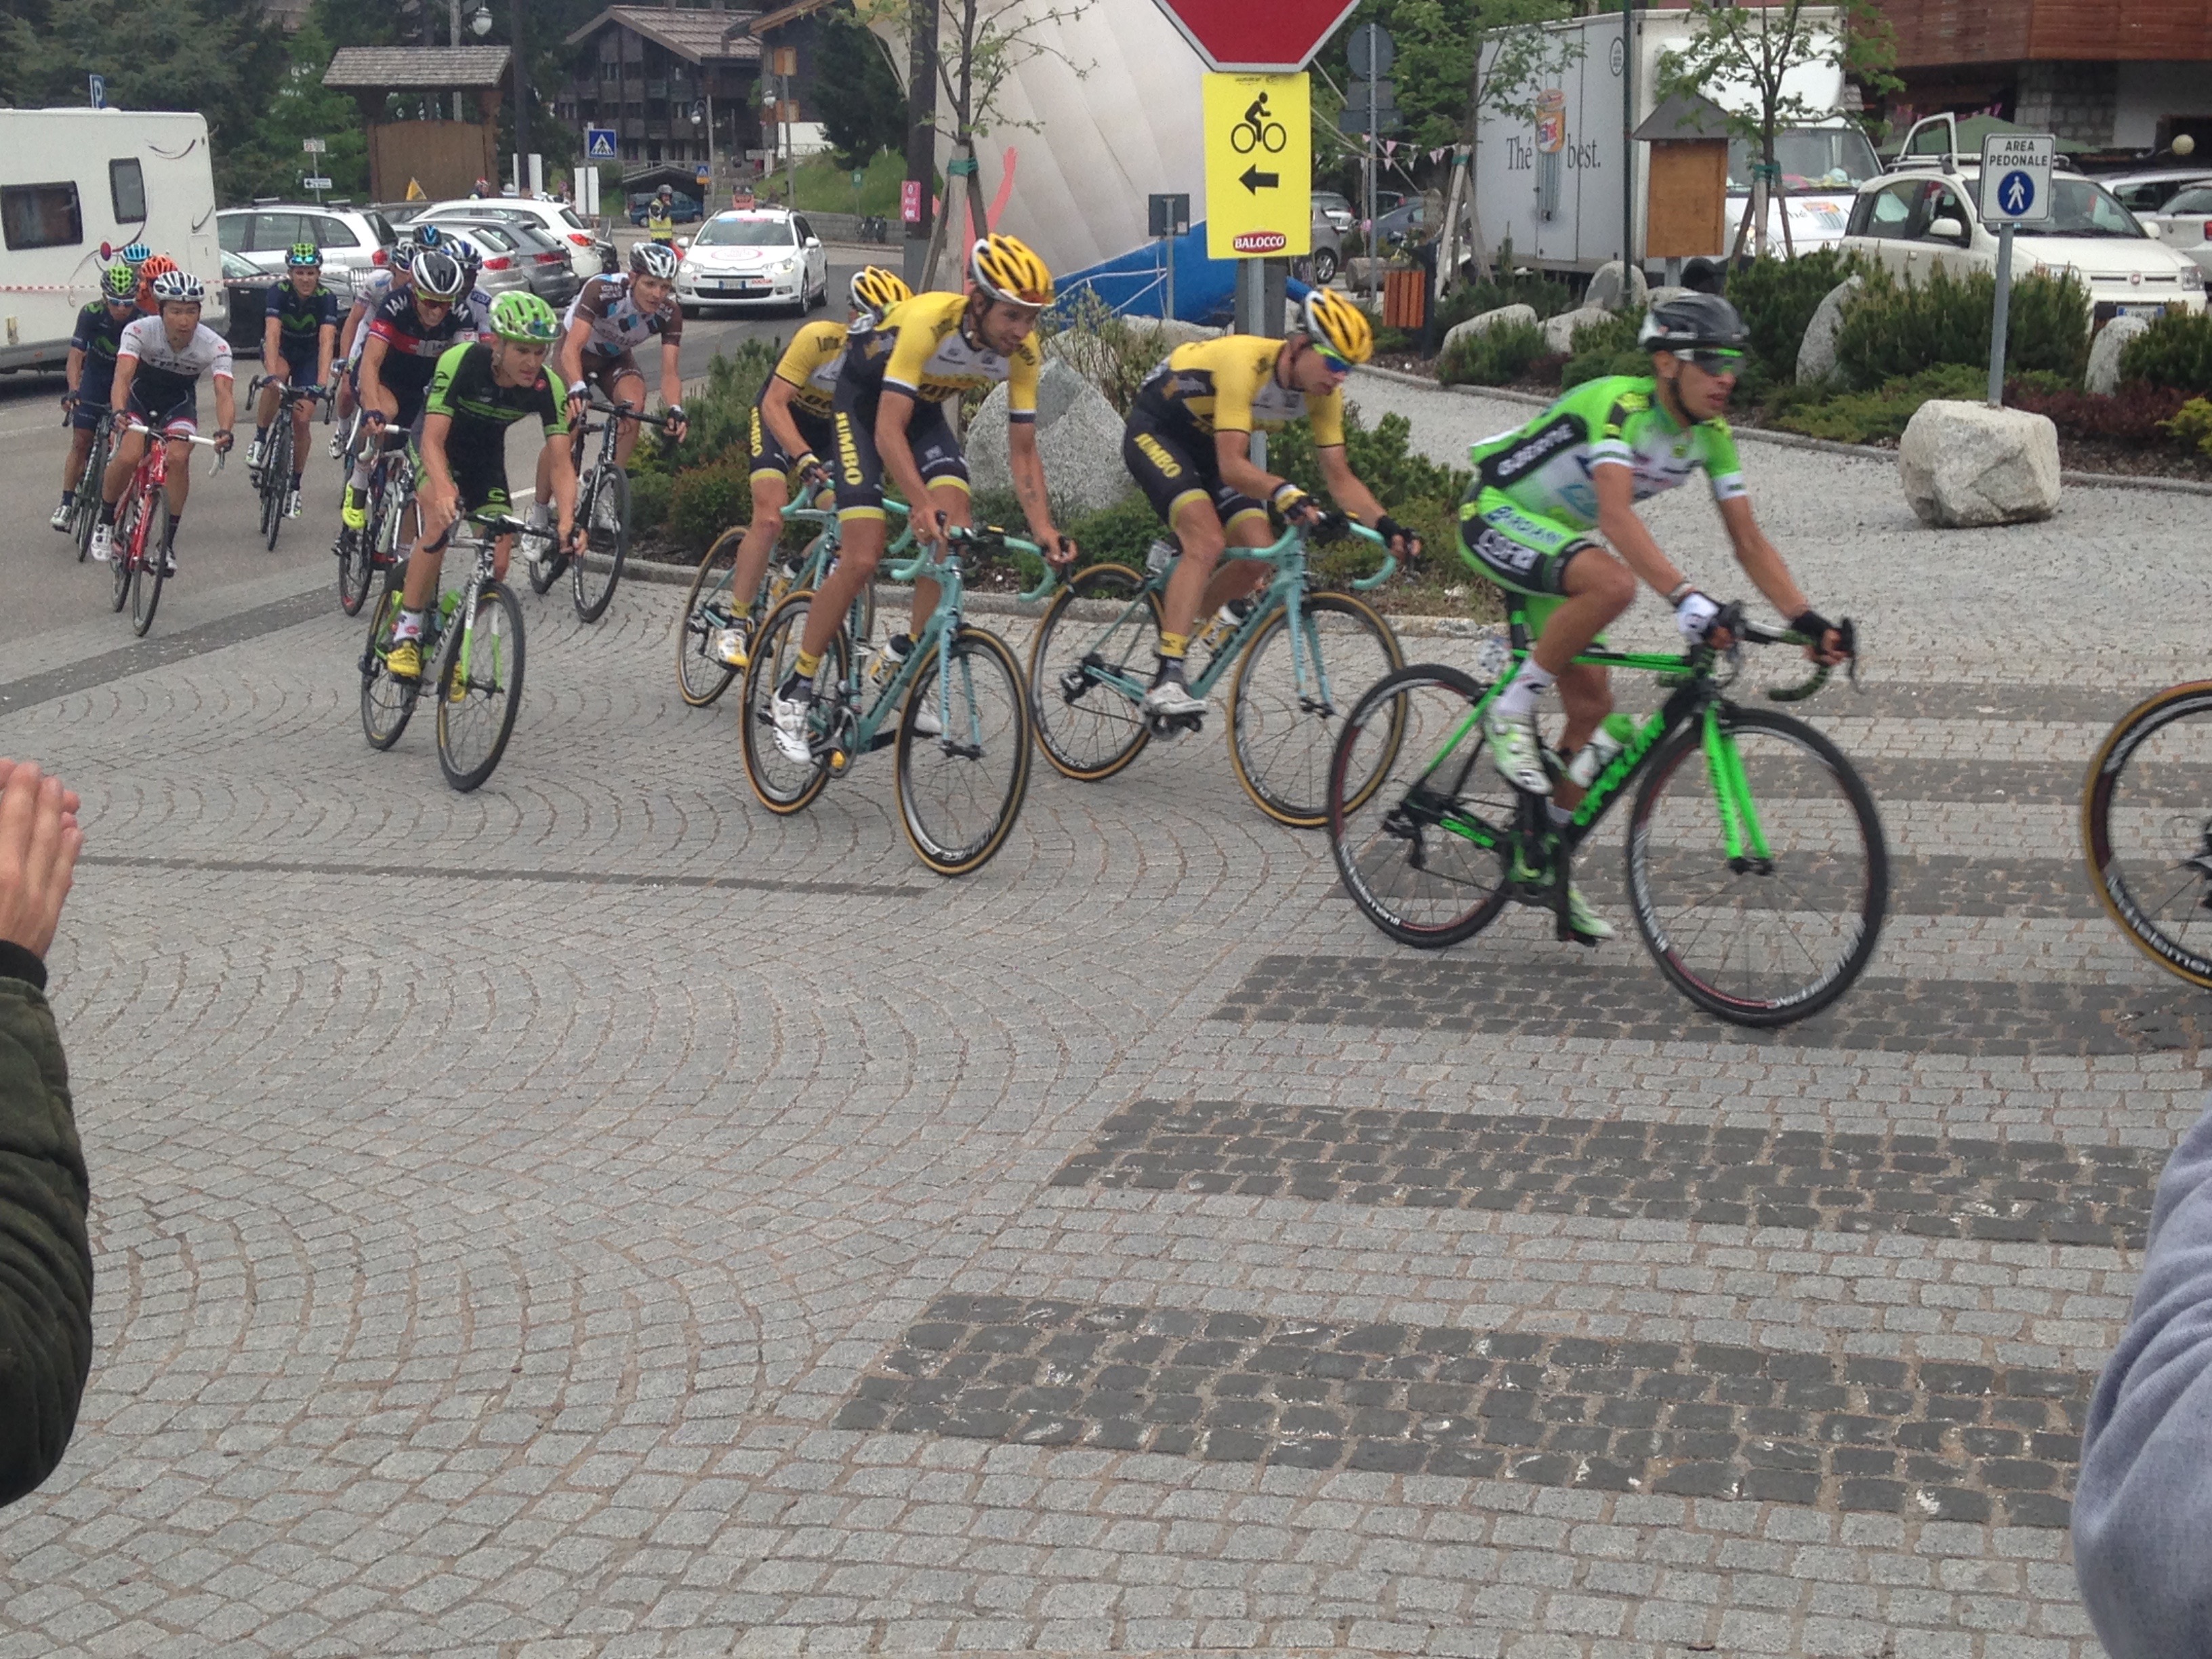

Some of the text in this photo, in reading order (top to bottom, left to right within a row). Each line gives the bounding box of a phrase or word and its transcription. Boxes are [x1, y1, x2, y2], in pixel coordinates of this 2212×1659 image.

[94, 80, 103, 108] P
[1506, 133, 1601, 169] Thé best.
[1989, 155, 2048, 167] PEDONALE
[2005, 140, 2034, 152] AREA
[1235, 236, 1285, 249] BALOCCO
[751, 407, 764, 458] JUMBO
[834, 411, 864, 486] JUMBO
[1132, 432, 1183, 478] JUMBO
